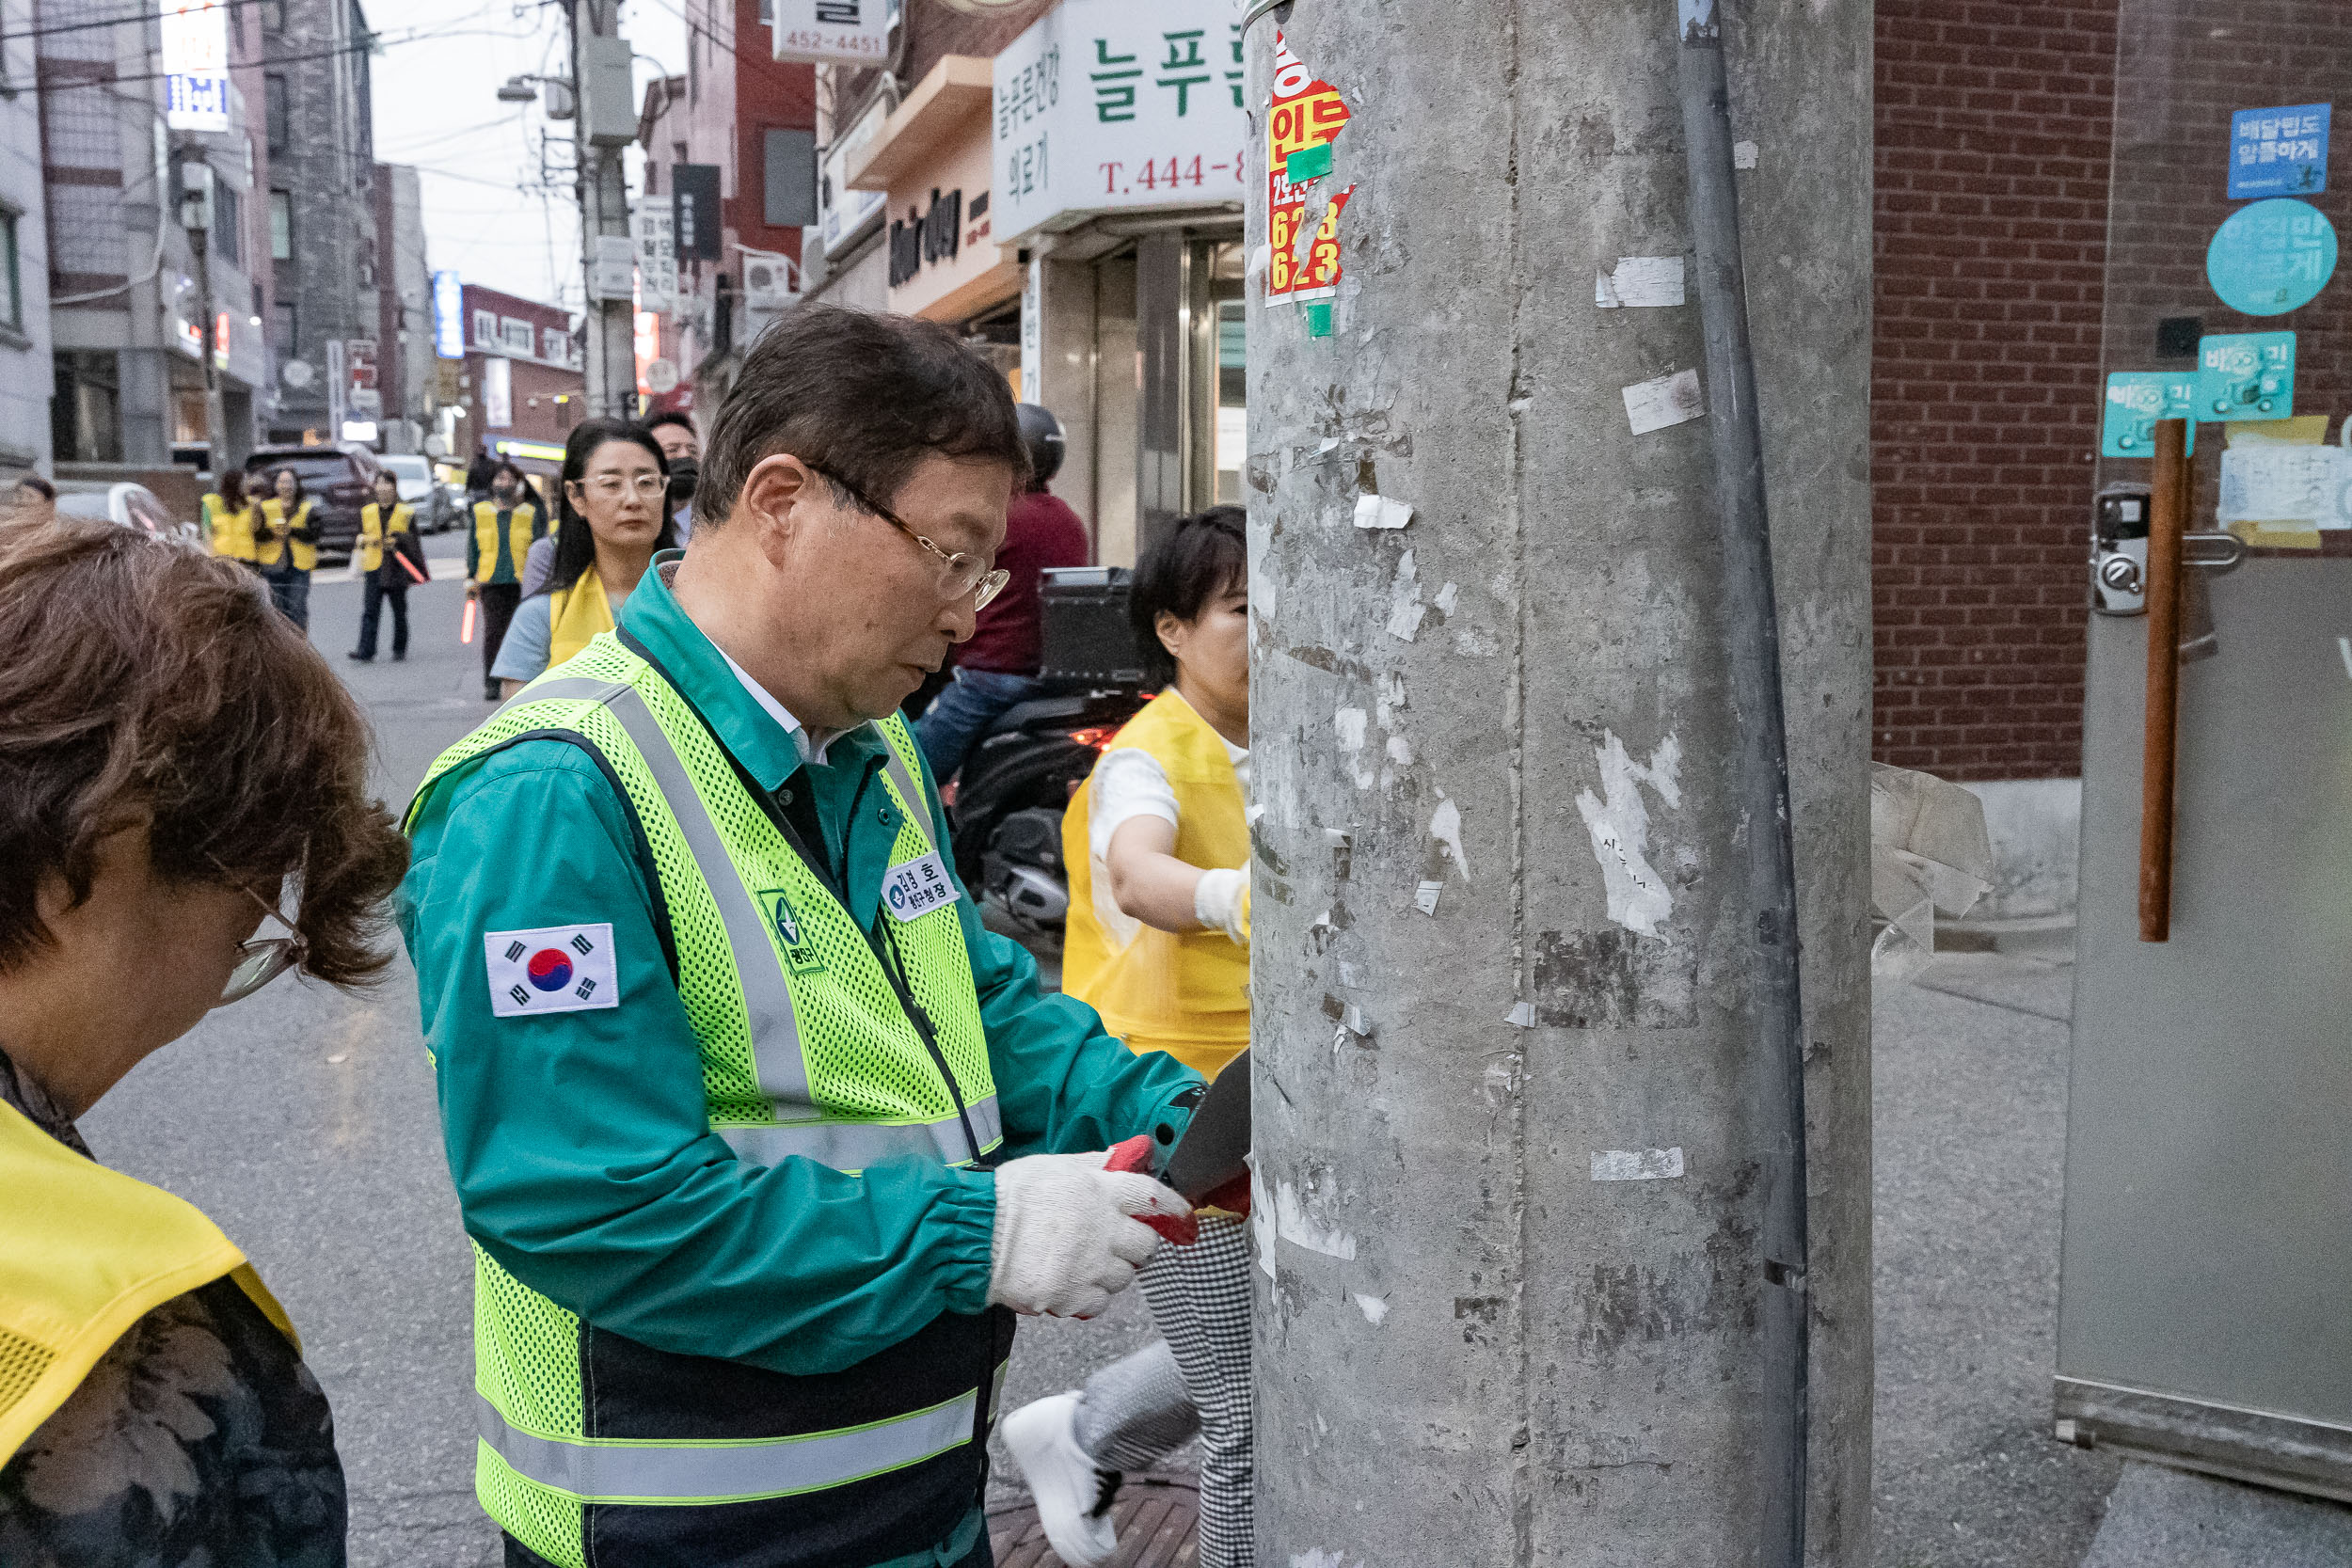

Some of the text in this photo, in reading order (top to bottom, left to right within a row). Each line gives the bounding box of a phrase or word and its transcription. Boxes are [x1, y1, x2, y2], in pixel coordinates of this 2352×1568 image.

[787, 29, 881, 53] 452-4451
[998, 42, 1060, 139] 늘푸른건강
[1009, 130, 1049, 206] 의료기
